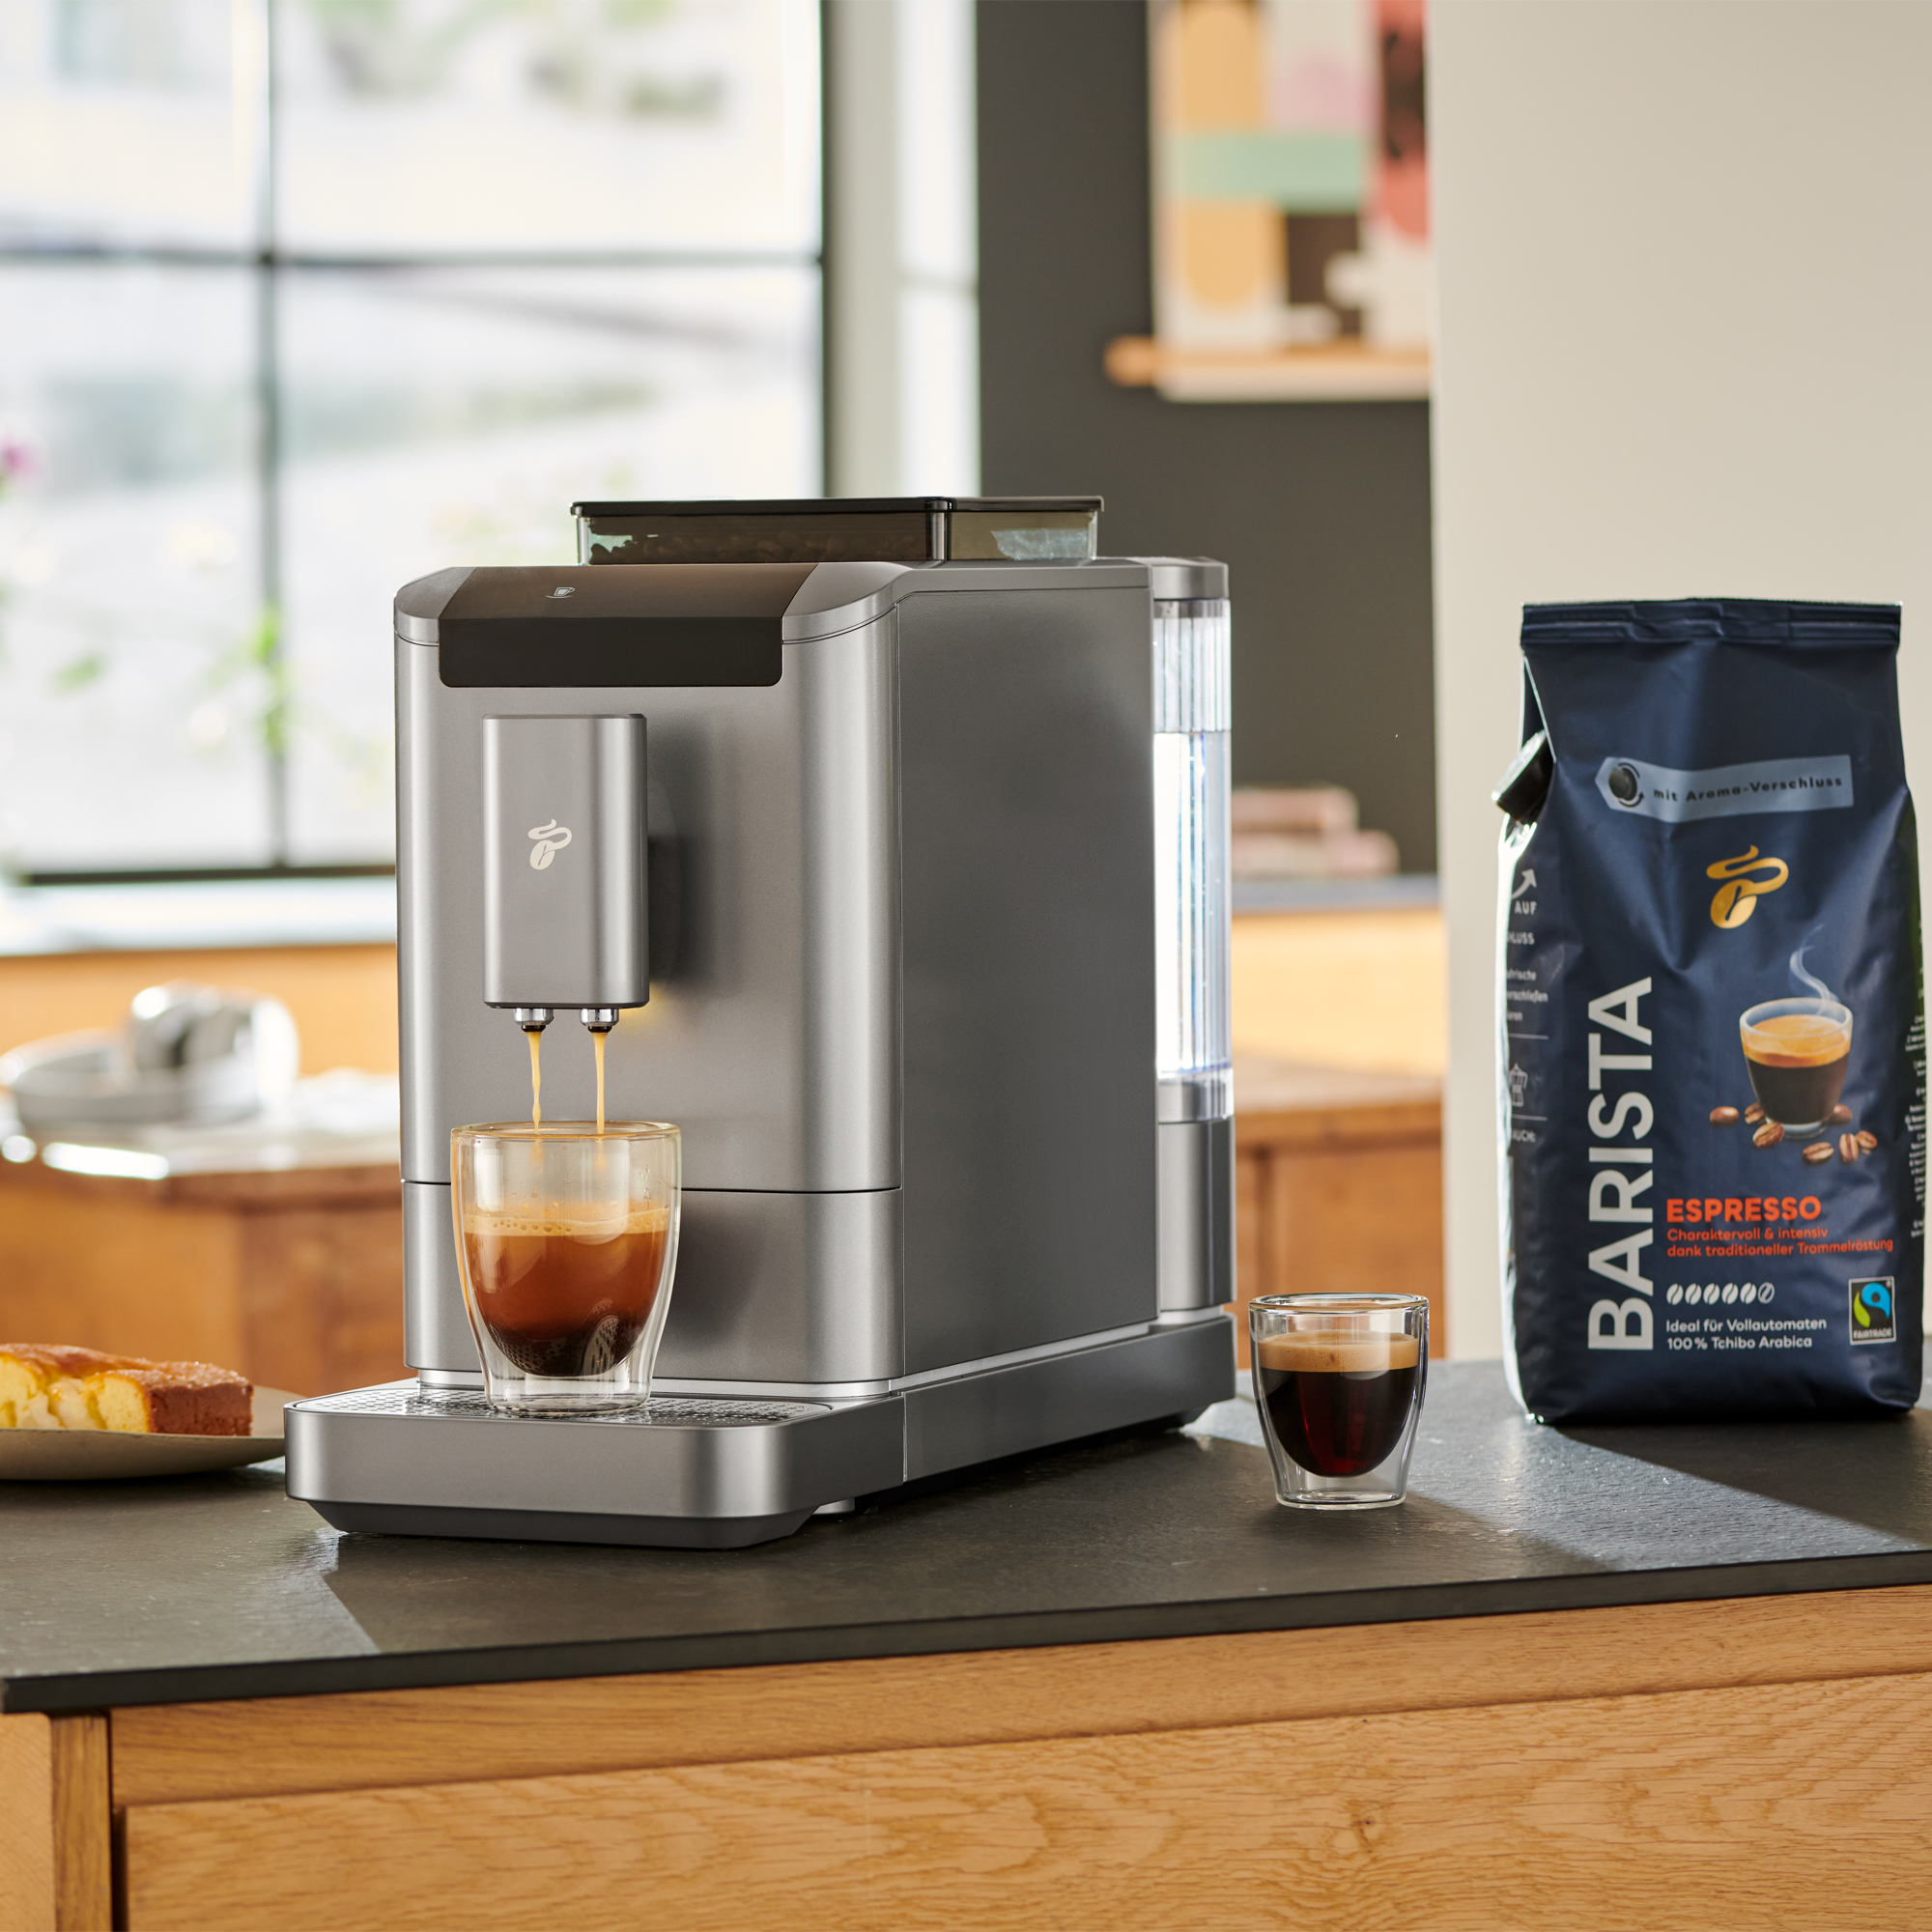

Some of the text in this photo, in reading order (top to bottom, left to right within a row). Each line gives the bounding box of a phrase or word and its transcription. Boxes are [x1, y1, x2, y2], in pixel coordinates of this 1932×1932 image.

[1653, 776, 1843, 802] mit Aroma-Verschluss
[1514, 899, 1538, 916] AUF
[1587, 977, 1654, 1350] BARISTA
[1666, 1195, 1822, 1224] ESPRESSO
[1666, 1225, 1829, 1242] Charaktervoll & intensiv
[1666, 1238, 1894, 1258] dank traditioneller Trommelröstung
[1665, 1318, 1828, 1333] Ideal für Vollautomaten
[1853, 1327, 1893, 1340] FAIRTRADE
[1711, 1335, 1756, 1350] Tchibo
[1758, 1334, 1813, 1349] Arabica
